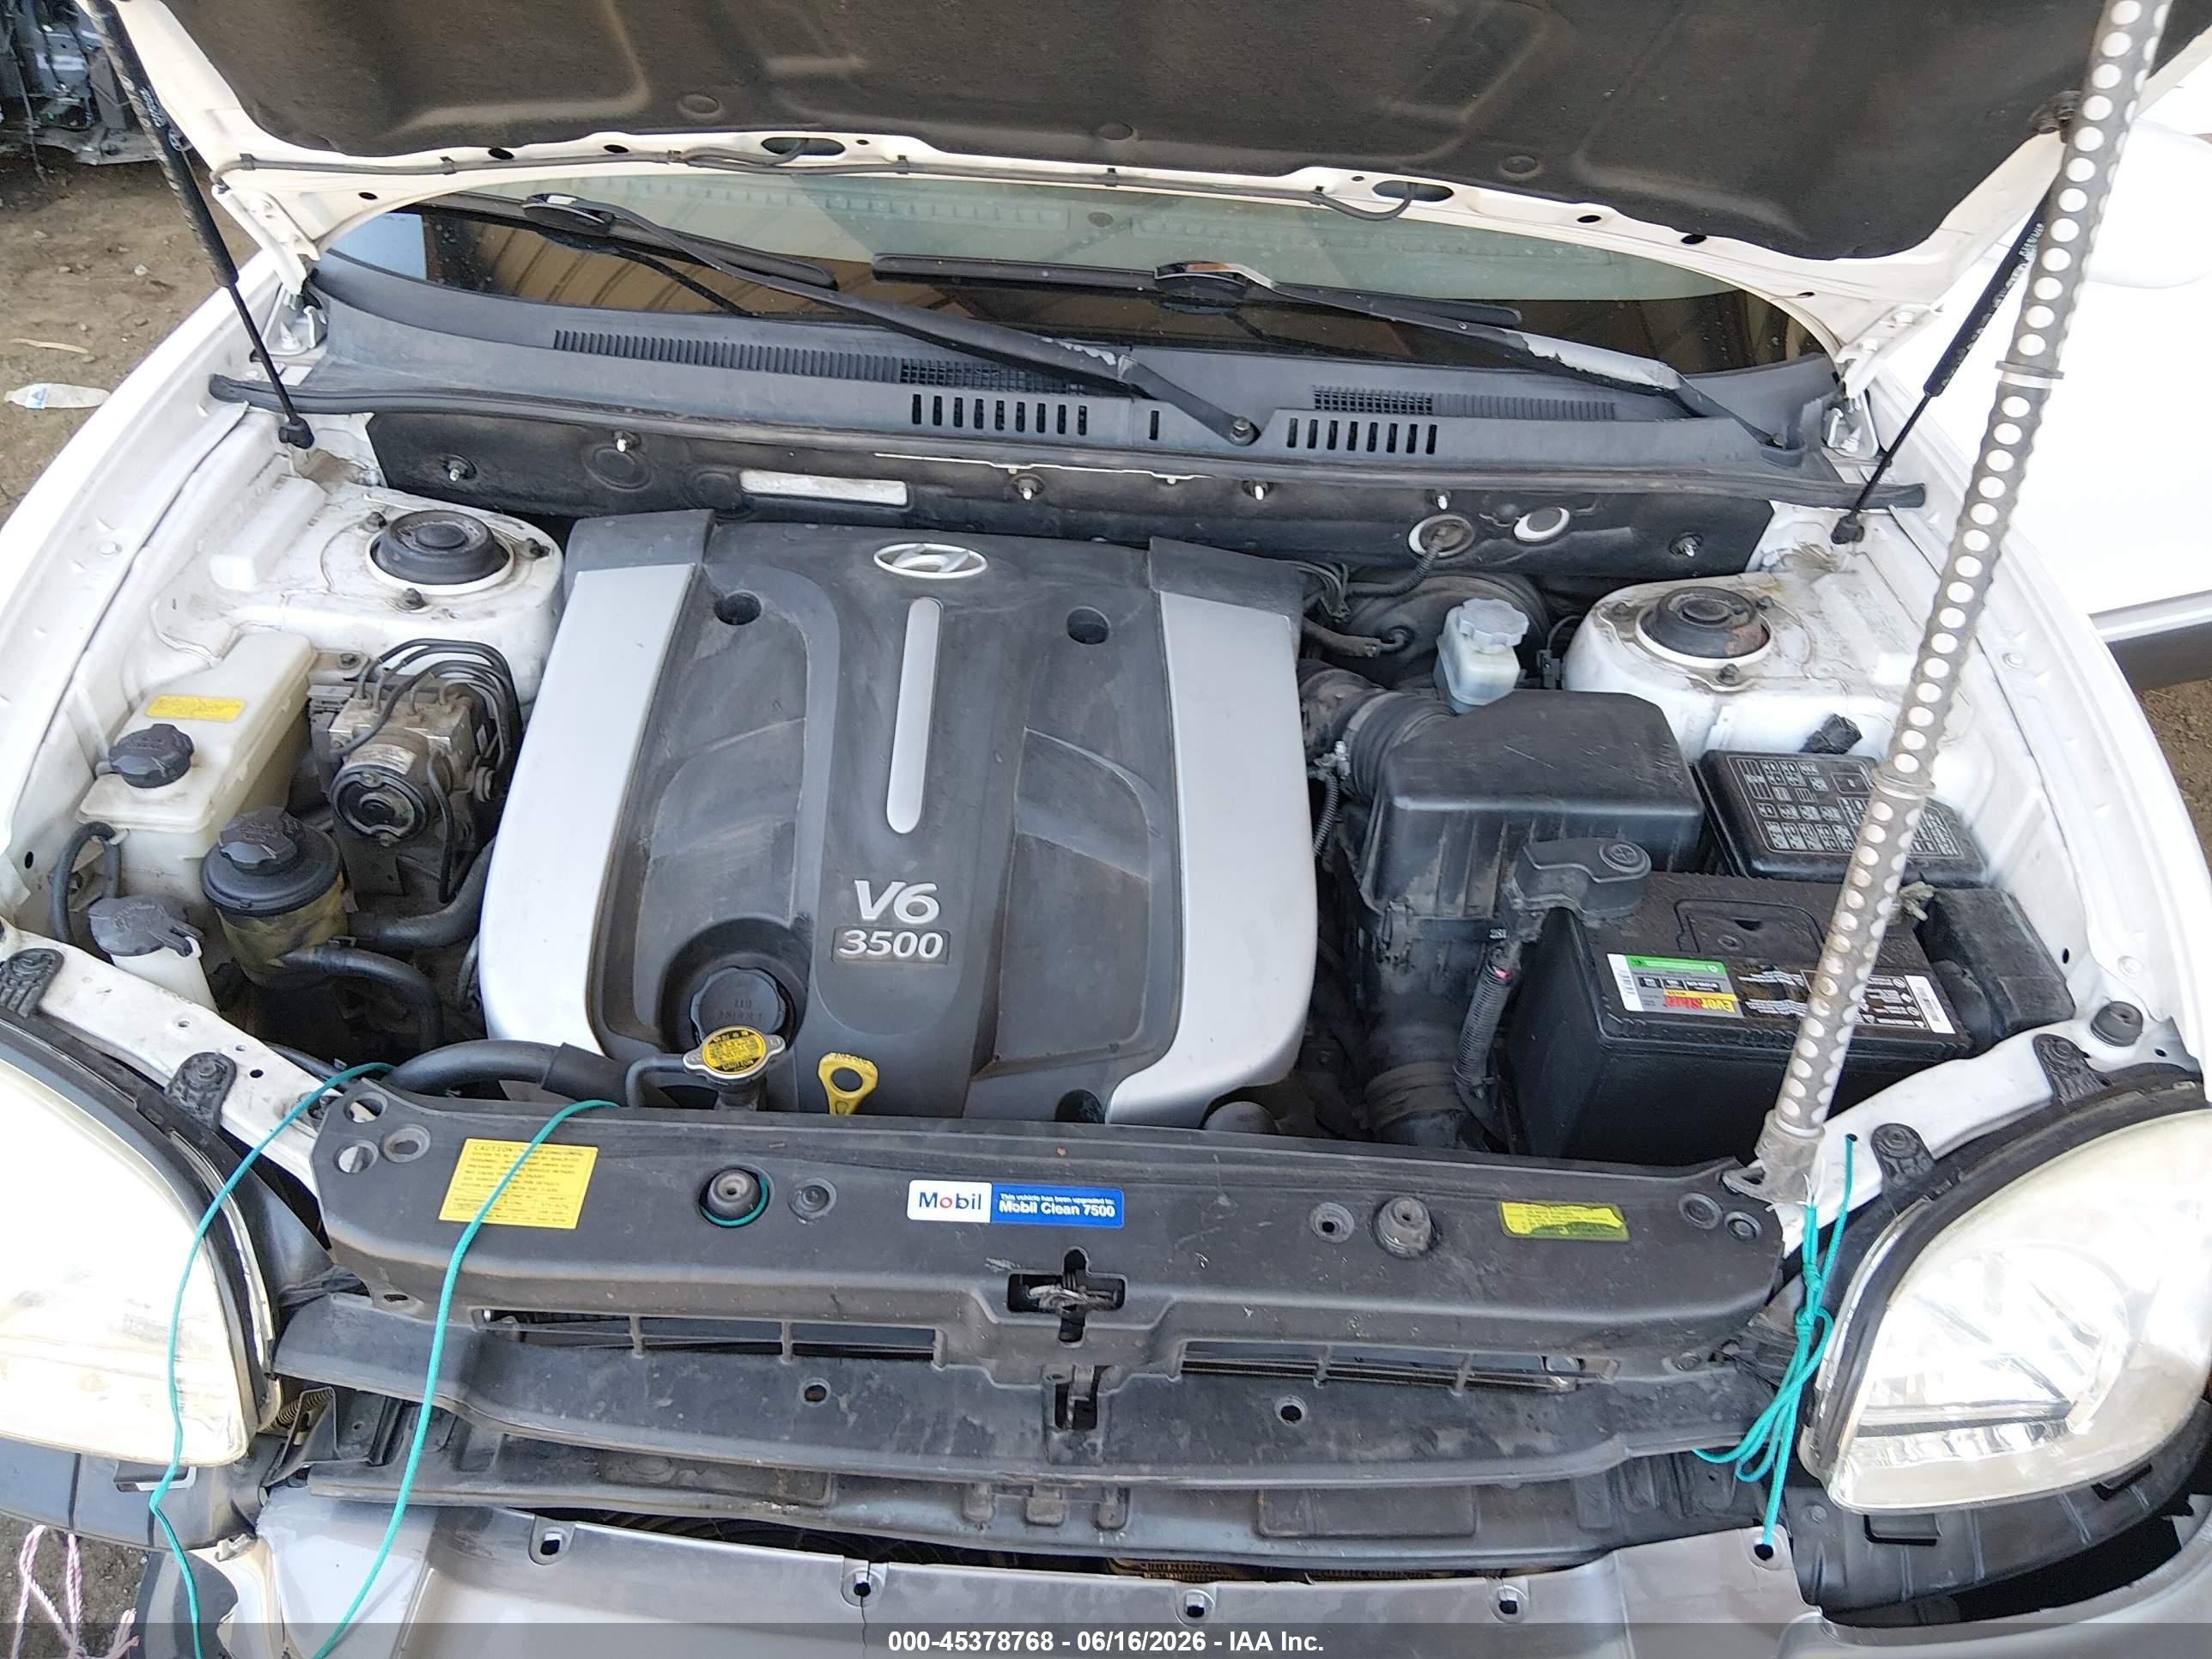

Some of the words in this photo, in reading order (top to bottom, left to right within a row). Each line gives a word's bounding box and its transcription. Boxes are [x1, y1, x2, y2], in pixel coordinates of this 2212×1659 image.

[854, 879, 940, 925] V6
[838, 929, 944, 959] 3500
[919, 1192, 981, 1209] Mobil
[999, 1200, 1038, 1214] Mobil
[1040, 1201, 1080, 1216] Clean
[1082, 1204, 1115, 1218] 7500
